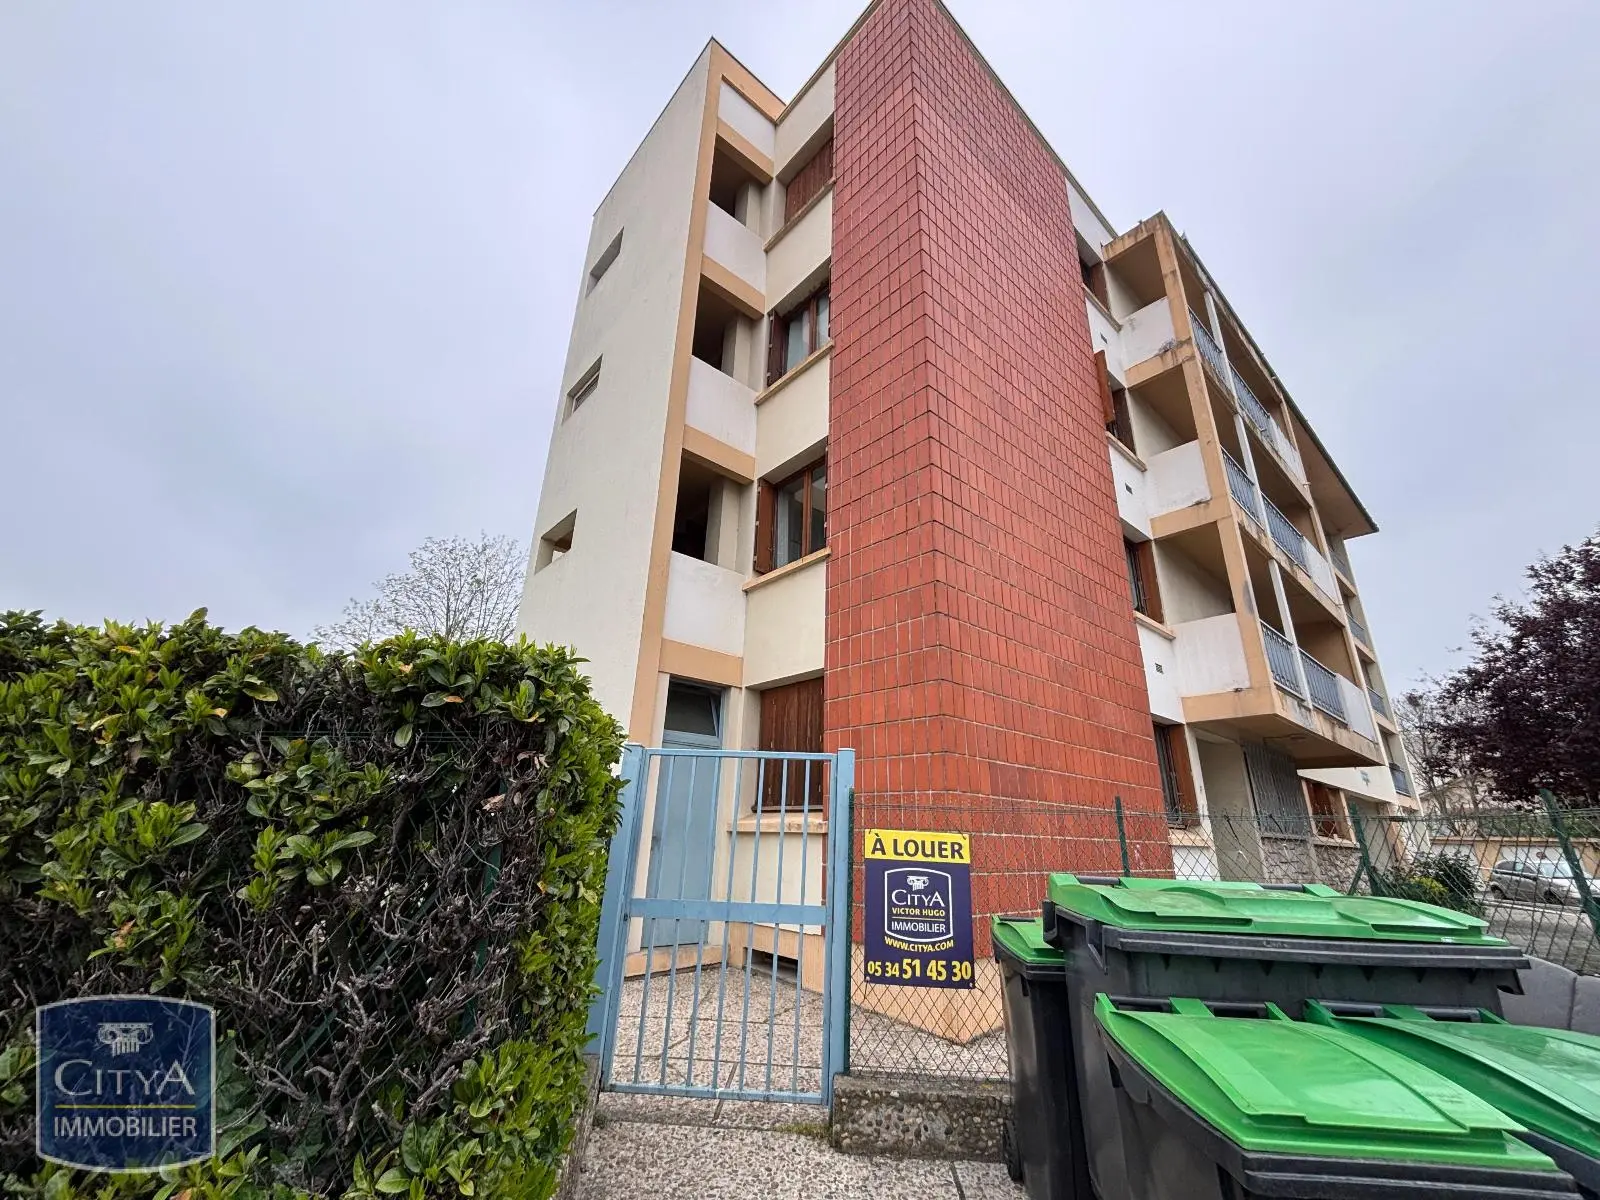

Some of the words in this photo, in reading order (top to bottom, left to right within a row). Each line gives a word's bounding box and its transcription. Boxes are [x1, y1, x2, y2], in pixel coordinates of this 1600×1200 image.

[871, 833, 886, 855] À
[893, 838, 964, 859] LOUER
[892, 907, 920, 916] VICTOR
[922, 908, 945, 917] HUGO
[891, 921, 946, 933] IMMOBILIER
[884, 936, 954, 953] WWW.CITYA.COM
[867, 960, 882, 975] 05
[885, 961, 899, 977] 34
[902, 958, 921, 979] 51
[926, 959, 947, 981] 45
[951, 960, 971, 982] 30
